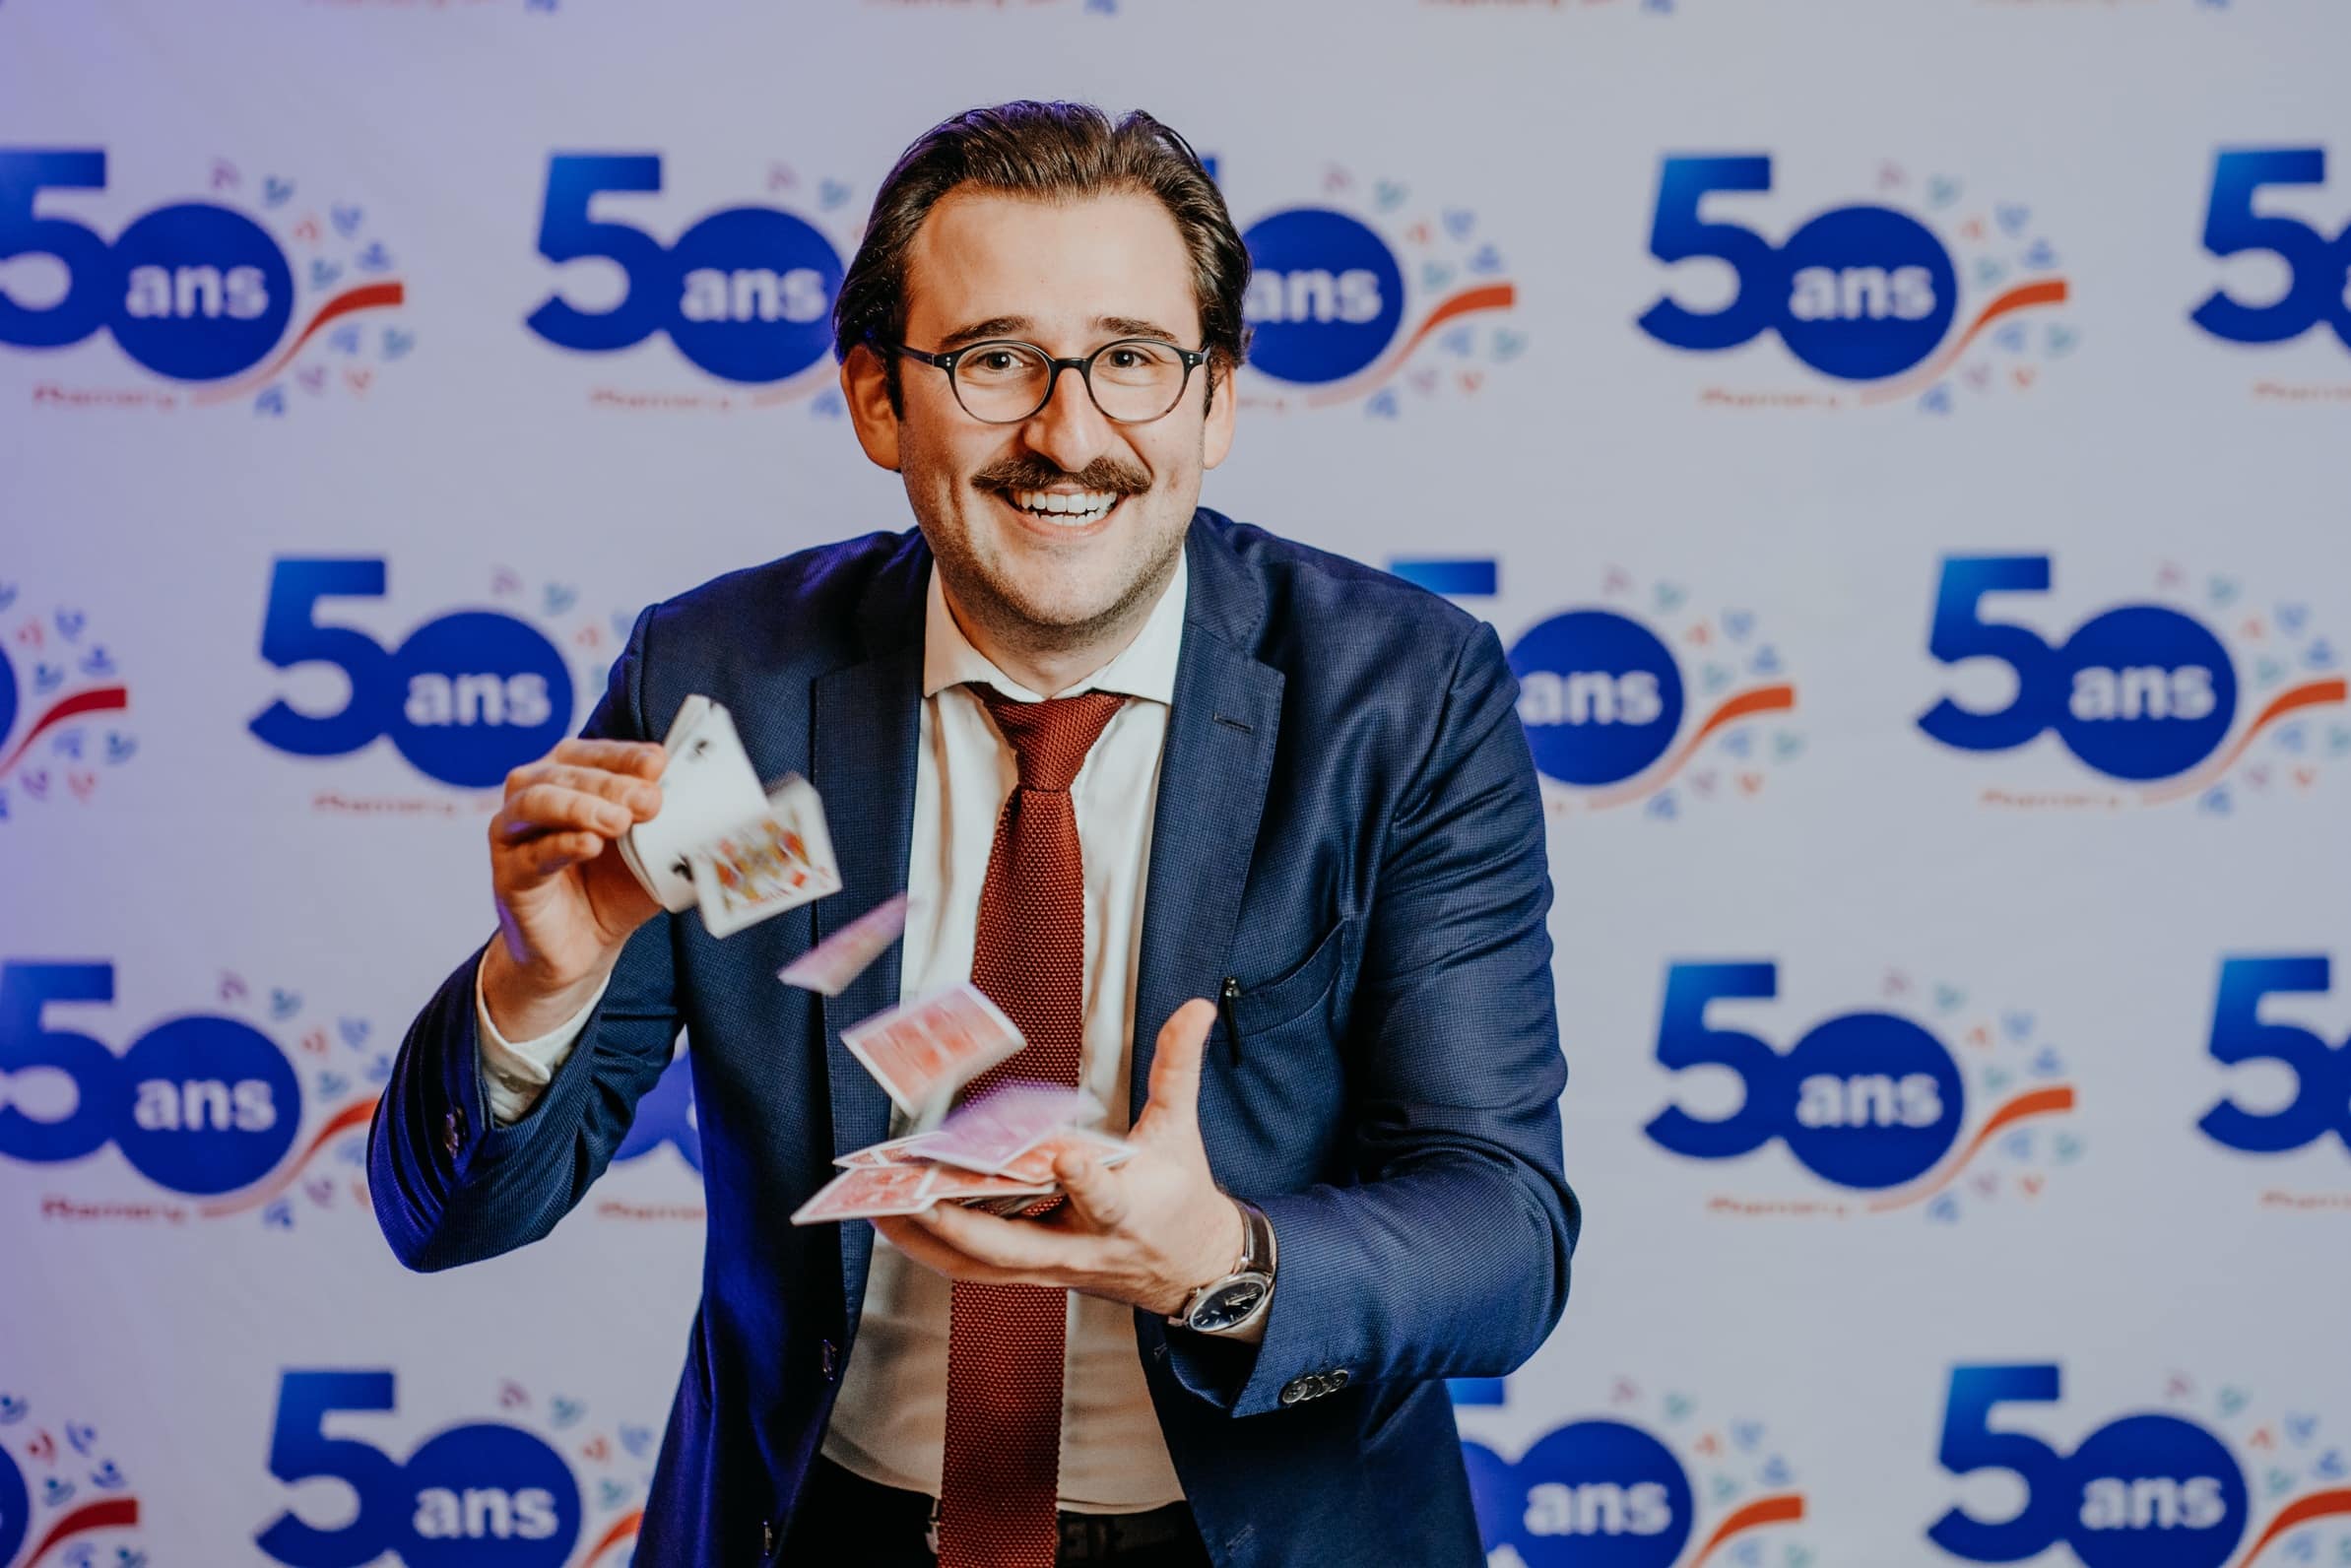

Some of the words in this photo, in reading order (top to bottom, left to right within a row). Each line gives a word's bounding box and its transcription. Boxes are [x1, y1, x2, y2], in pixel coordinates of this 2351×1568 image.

[0, 149, 294, 382] 50
[525, 154, 847, 384] 50
[1637, 155, 1959, 381] 50
[2189, 147, 2351, 352] 5
[125, 265, 269, 319] ans
[681, 268, 828, 323] ans
[1243, 268, 1384, 324] ans
[1789, 266, 1936, 321] ans
[248, 557, 575, 790] 50
[1917, 555, 2239, 782] 50
[2069, 666, 2217, 721] ans
[404, 673, 552, 727] ans
[1515, 671, 1663, 727] ans
[0, 961, 302, 1196] 50
[1644, 961, 1965, 1191] 50
[2196, 955, 2351, 1155] 5
[134, 1079, 277, 1133] ans
[1796, 1074, 1943, 1128] ans
[254, 1370, 583, 1568] 50
[1926, 1363, 2251, 1568] 50
[413, 1487, 558, 1539] ans
[1523, 1481, 1672, 1536] ans
[2080, 1476, 2227, 1530] ans
